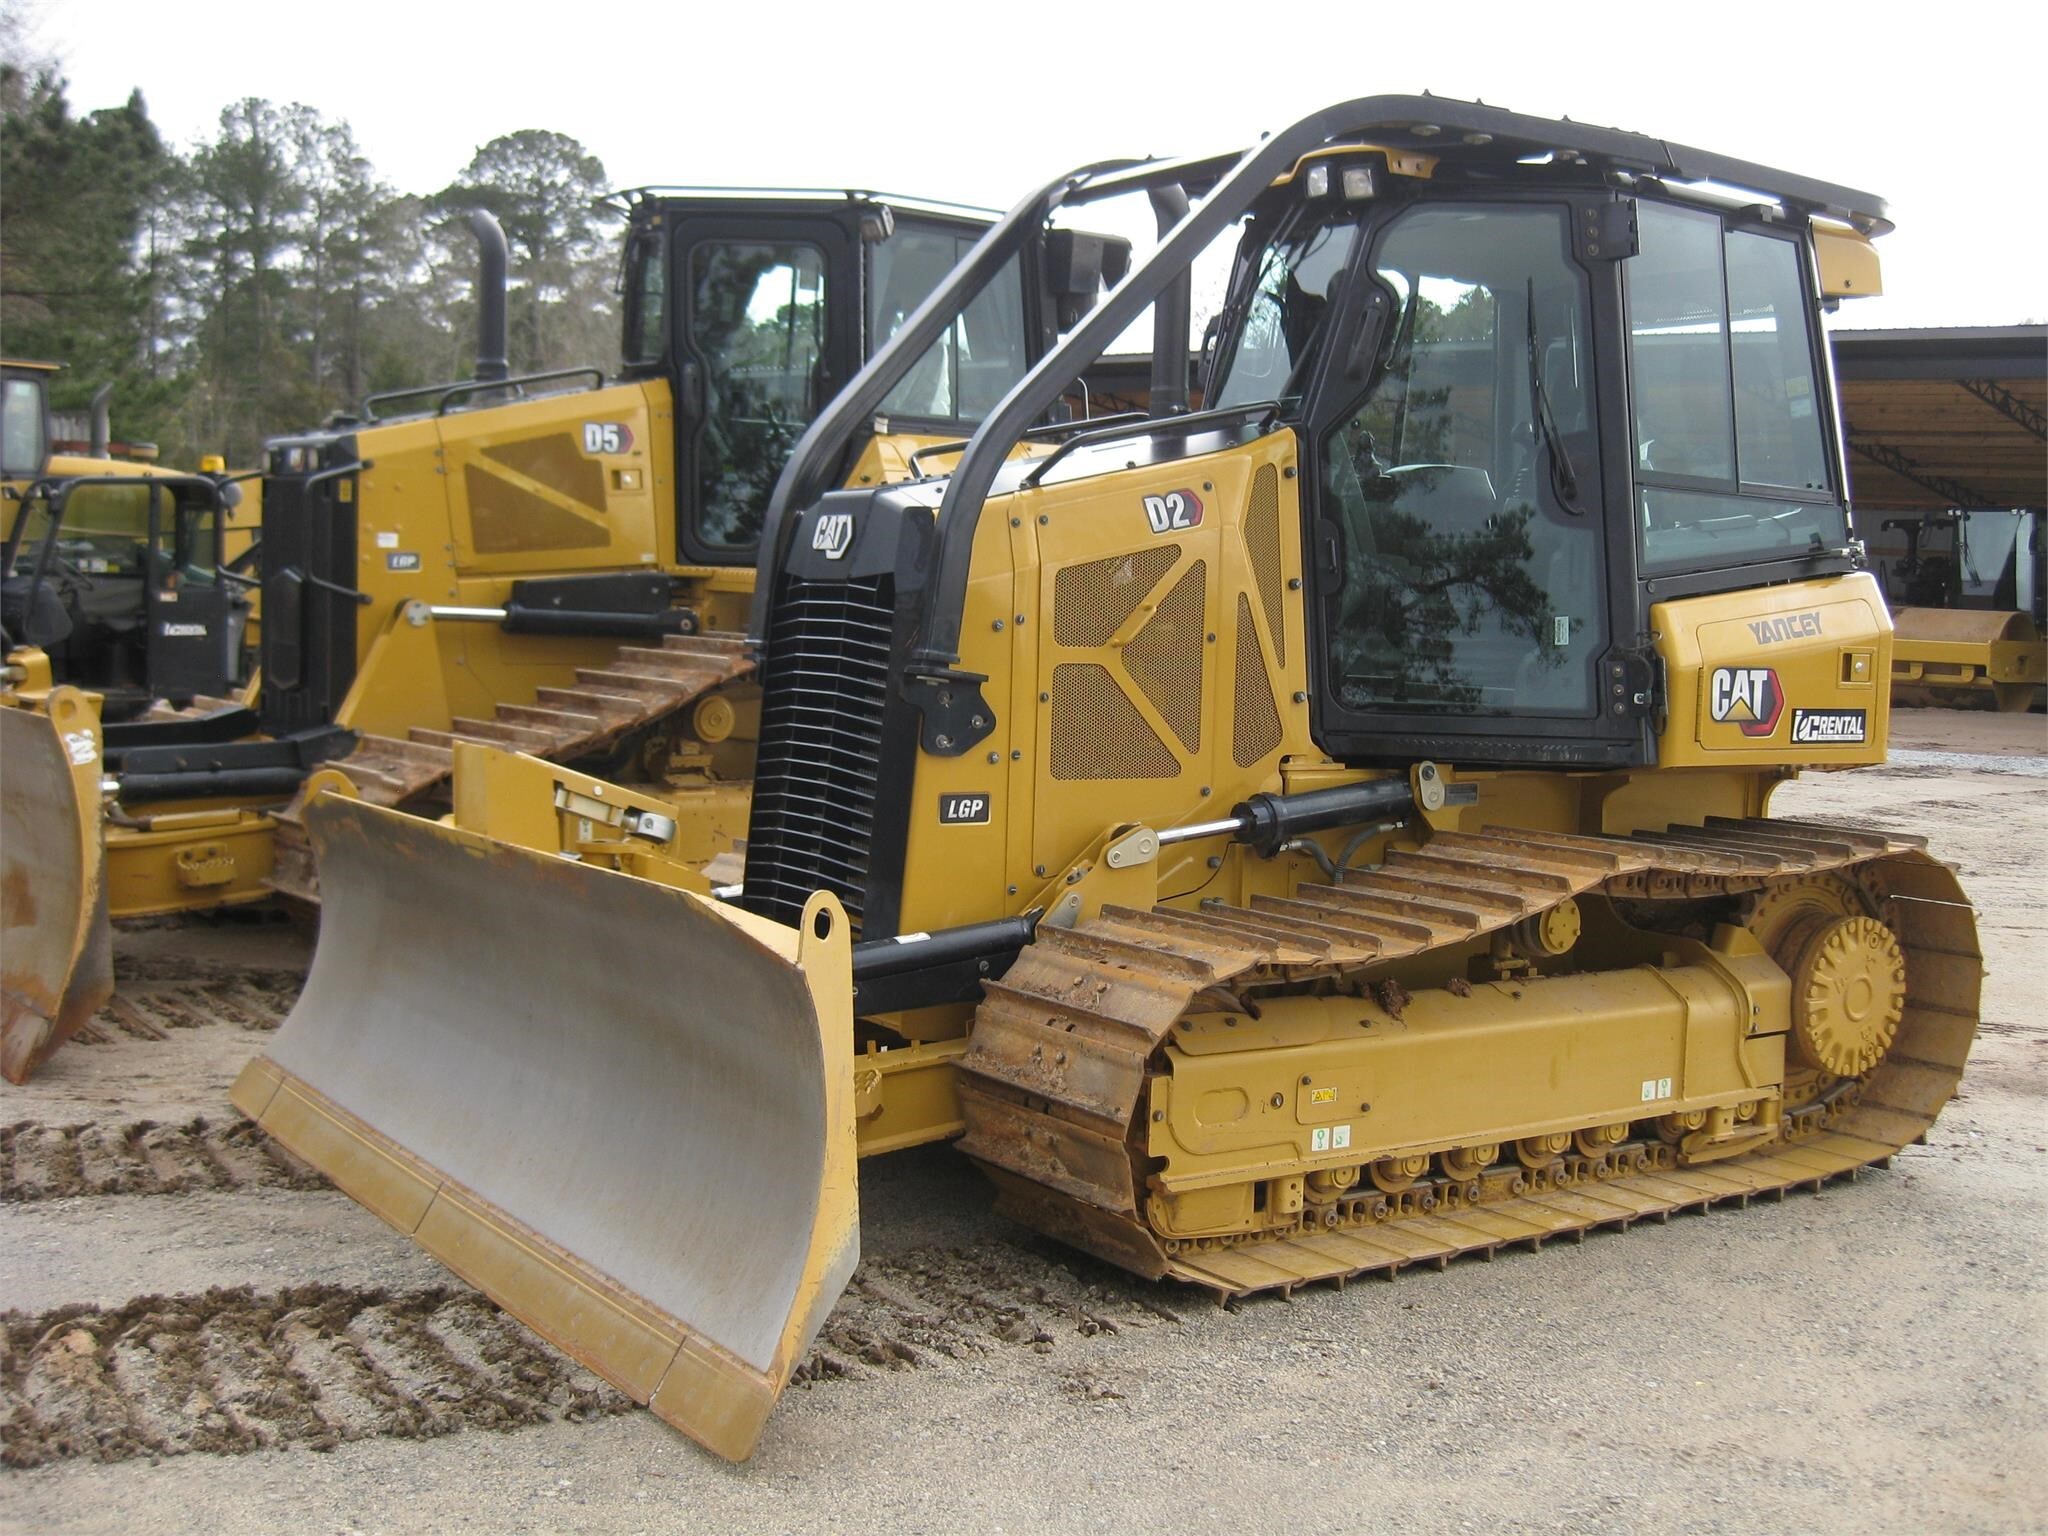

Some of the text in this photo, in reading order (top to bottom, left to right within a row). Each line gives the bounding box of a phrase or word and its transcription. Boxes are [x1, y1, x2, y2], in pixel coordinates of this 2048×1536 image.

[584, 422, 620, 453] D5
[1143, 492, 1191, 533] D2
[812, 514, 849, 551] CAT
[1746, 611, 1823, 646] YANCEY
[1711, 668, 1769, 721] CAT
[1819, 716, 1864, 735] RENTAL
[947, 799, 984, 819] LGP
